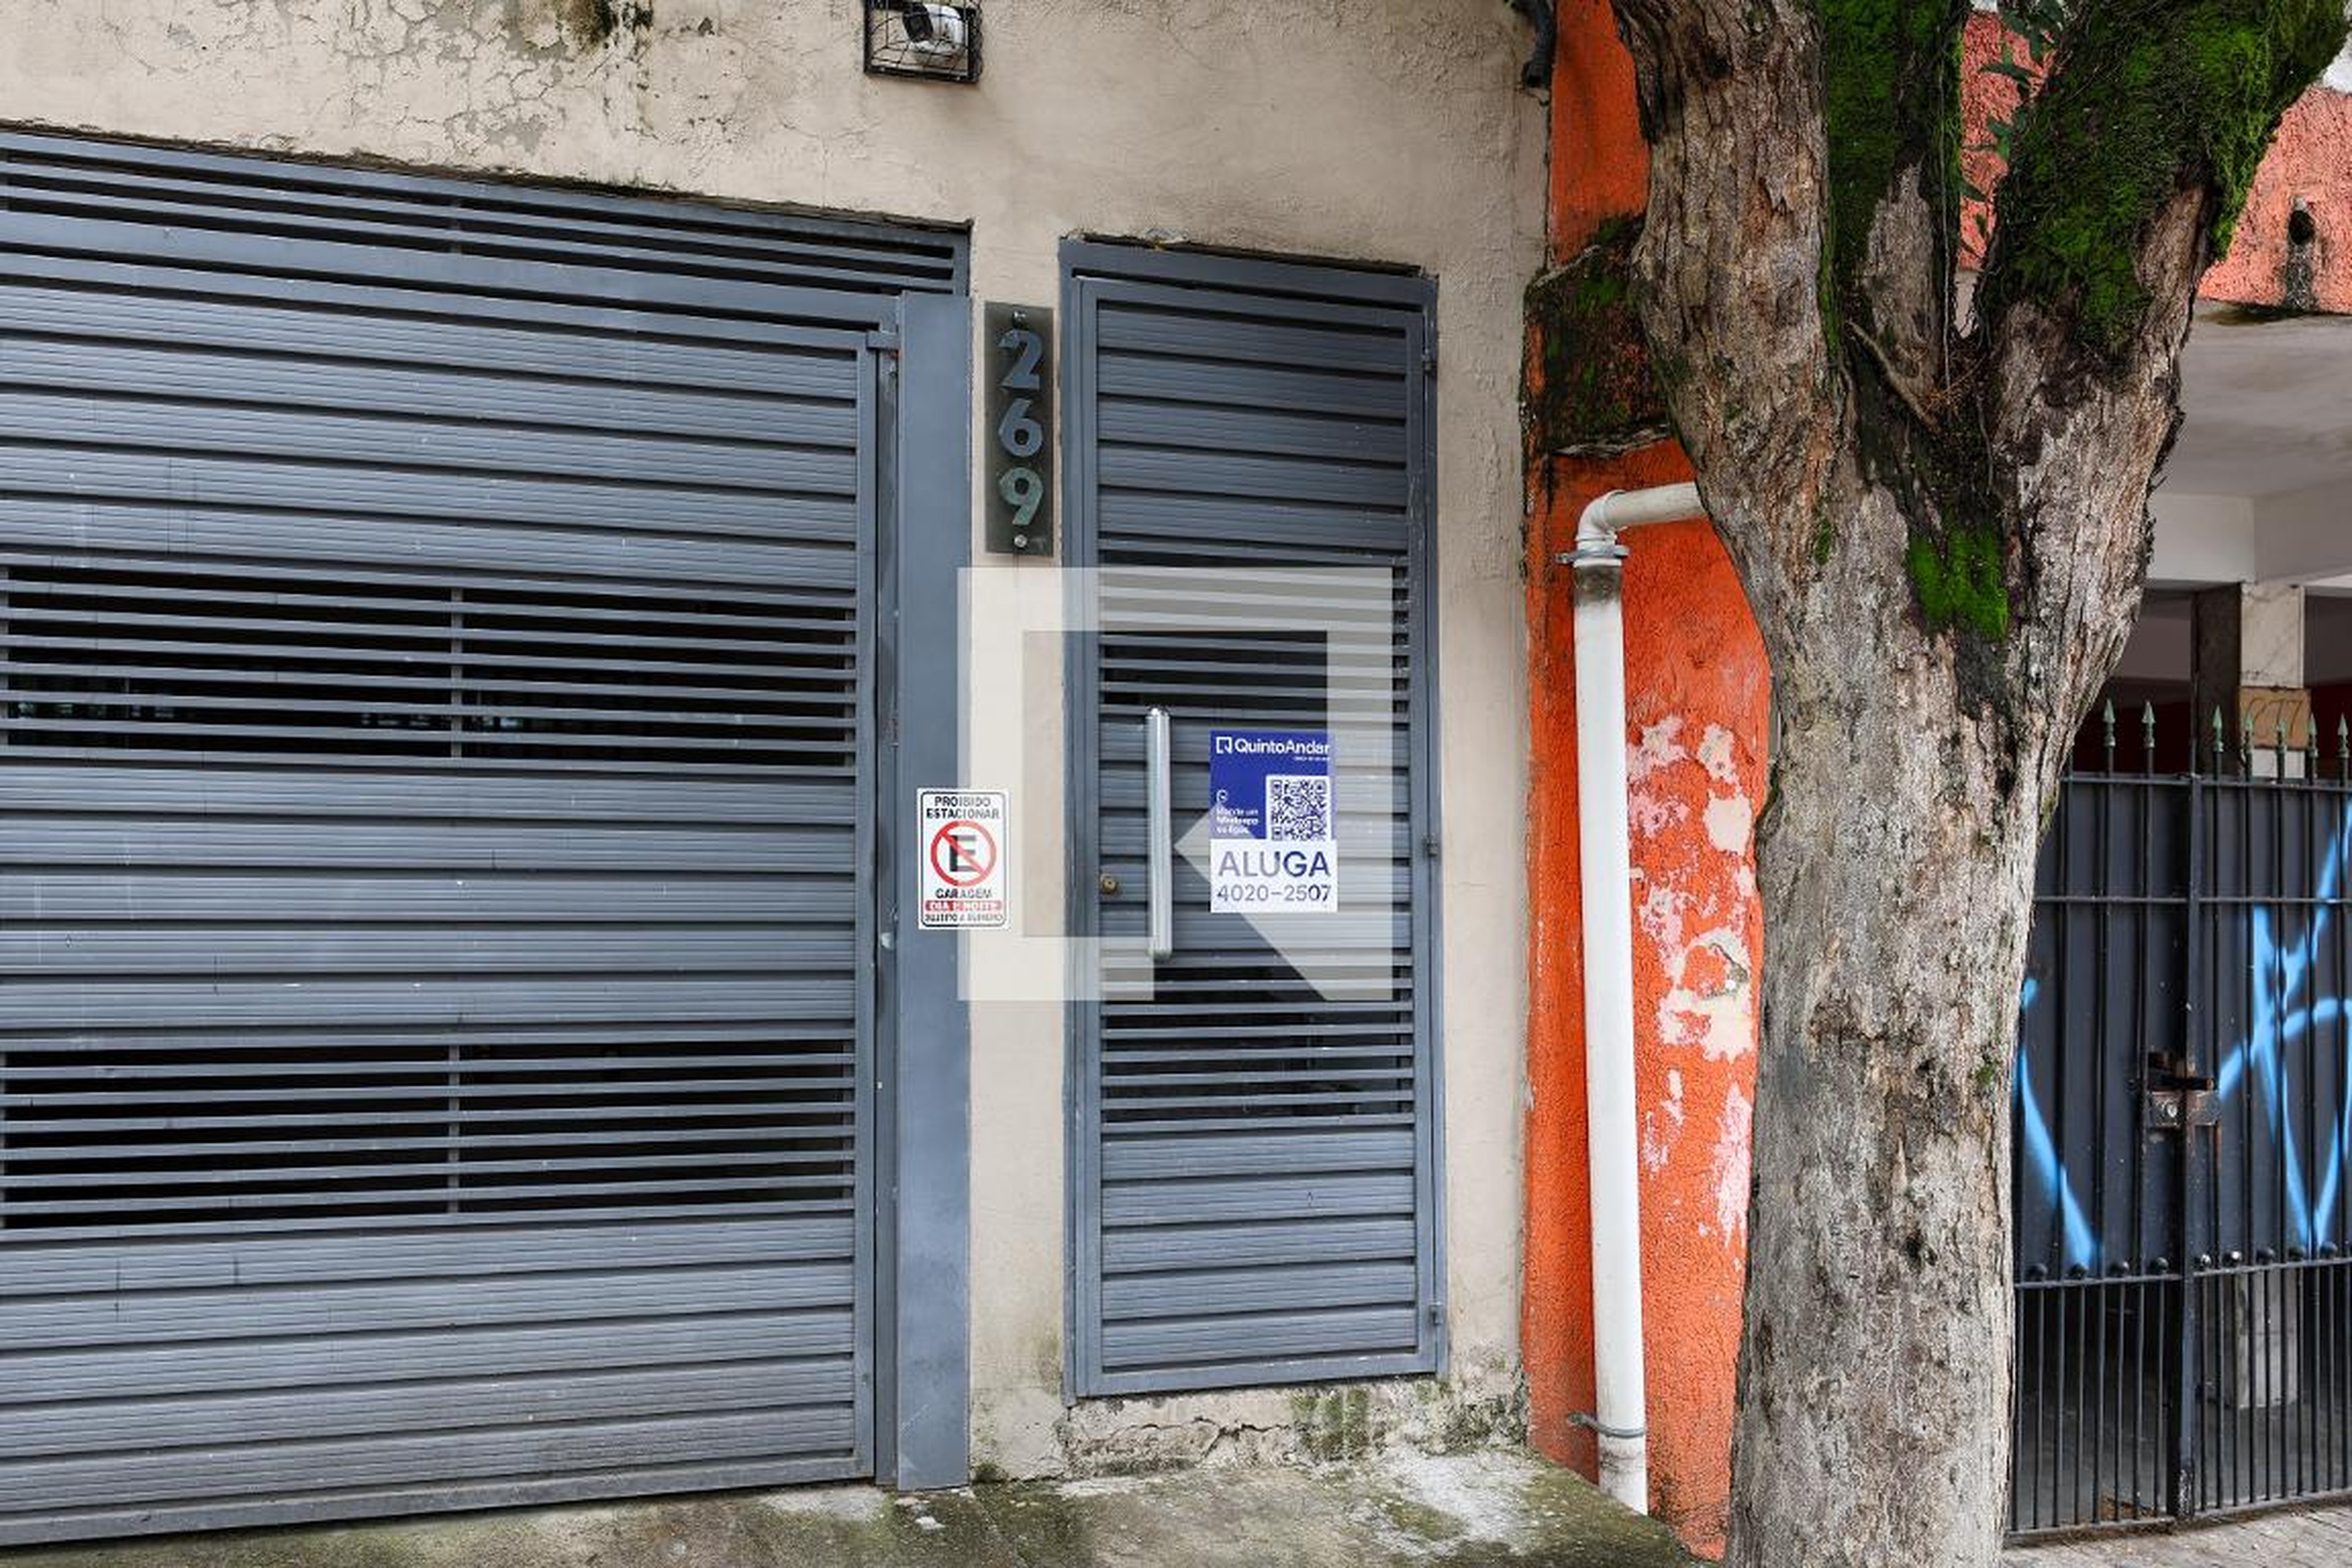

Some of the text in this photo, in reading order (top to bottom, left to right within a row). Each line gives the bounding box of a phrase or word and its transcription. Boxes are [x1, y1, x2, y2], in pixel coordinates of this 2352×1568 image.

[997, 328, 1044, 527] 269
[1234, 738, 1331, 755] QuintoAndar
[934, 796, 991, 807] PROIBIDO
[925, 808, 1000, 820] ESTACIONAR
[1218, 851, 1332, 877] ALUGA
[935, 888, 992, 899] GARAGEM
[1216, 884, 1332, 902] 4020-2507
